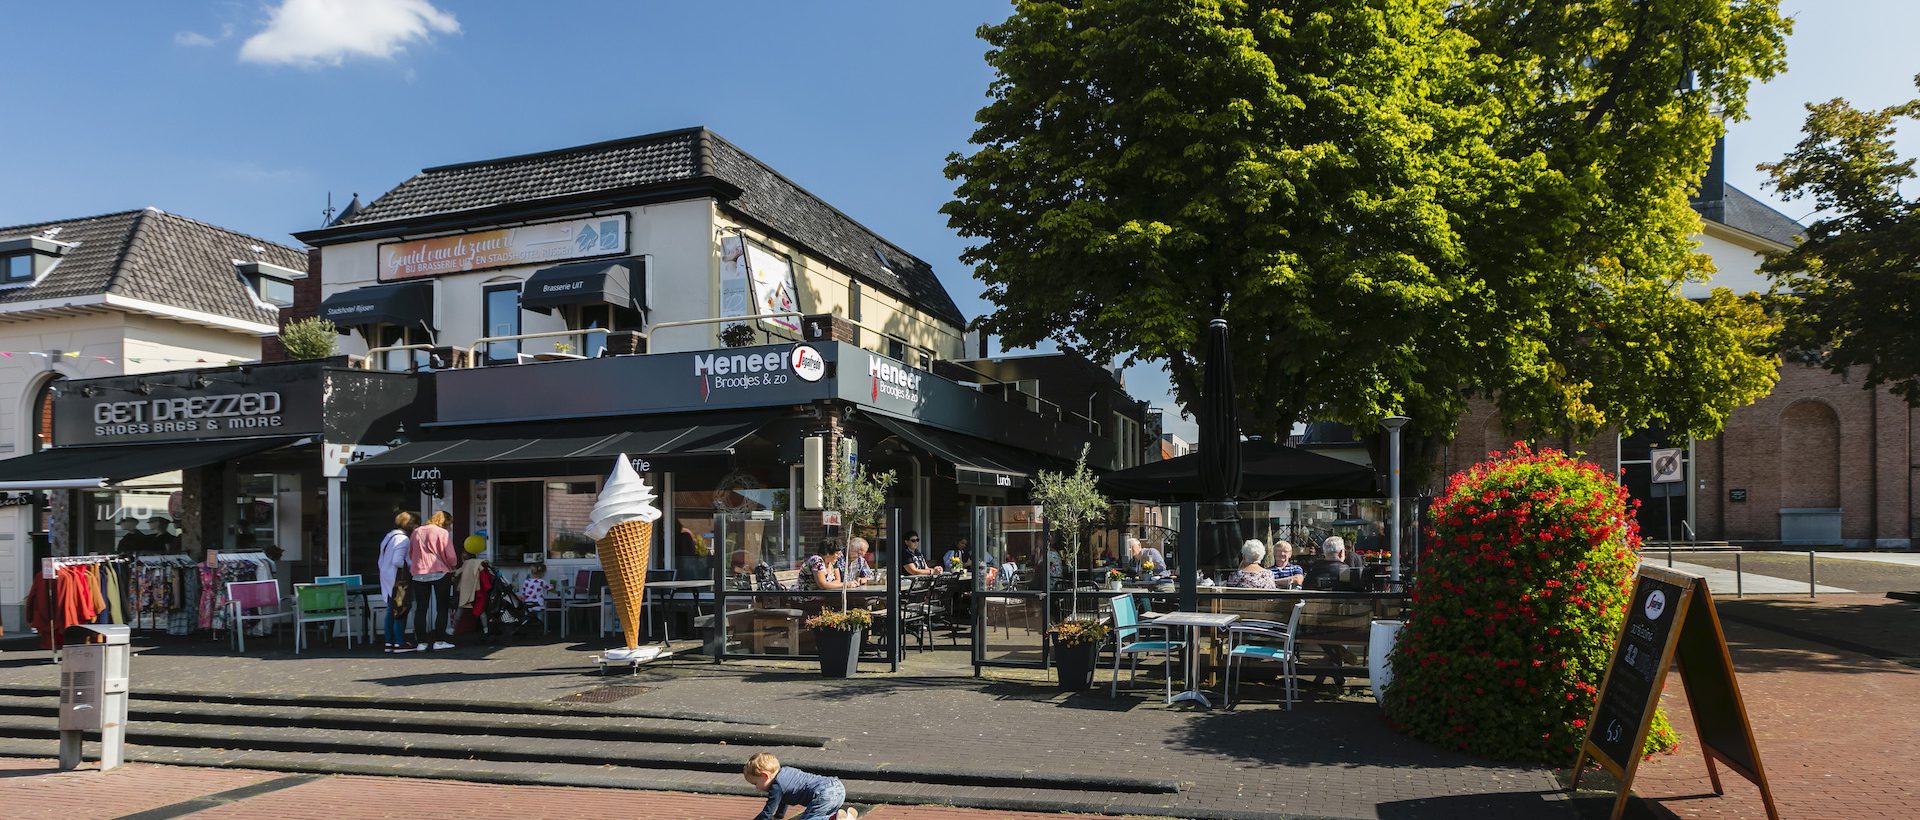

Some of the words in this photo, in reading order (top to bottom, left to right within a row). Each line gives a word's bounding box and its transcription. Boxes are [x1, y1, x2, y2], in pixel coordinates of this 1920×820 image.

[405, 263, 416, 273] BIJ
[417, 258, 457, 272] BRASSERIE
[476, 255, 487, 265] EN
[542, 283, 571, 293] Brasserie
[571, 280, 584, 290] UIT
[327, 305, 355, 316] Stadshotel
[355, 304, 375, 313] Rijssen
[694, 350, 790, 377] Meneer
[869, 354, 922, 391] Meneer
[715, 374, 761, 390] Broodjes
[762, 373, 772, 386] &
[773, 374, 788, 385] zo
[879, 380, 905, 400] Broodjes
[905, 388, 911, 401] &
[911, 392, 919, 403] zo
[94, 400, 148, 424] GET
[152, 391, 282, 422] DREZZED
[95, 423, 150, 436] SHOES
[153, 420, 198, 433] BAGS
[206, 419, 219, 430] &
[229, 416, 282, 429] MORE
[411, 466, 442, 480] Lunch
[996, 473, 1012, 487] Lunch
